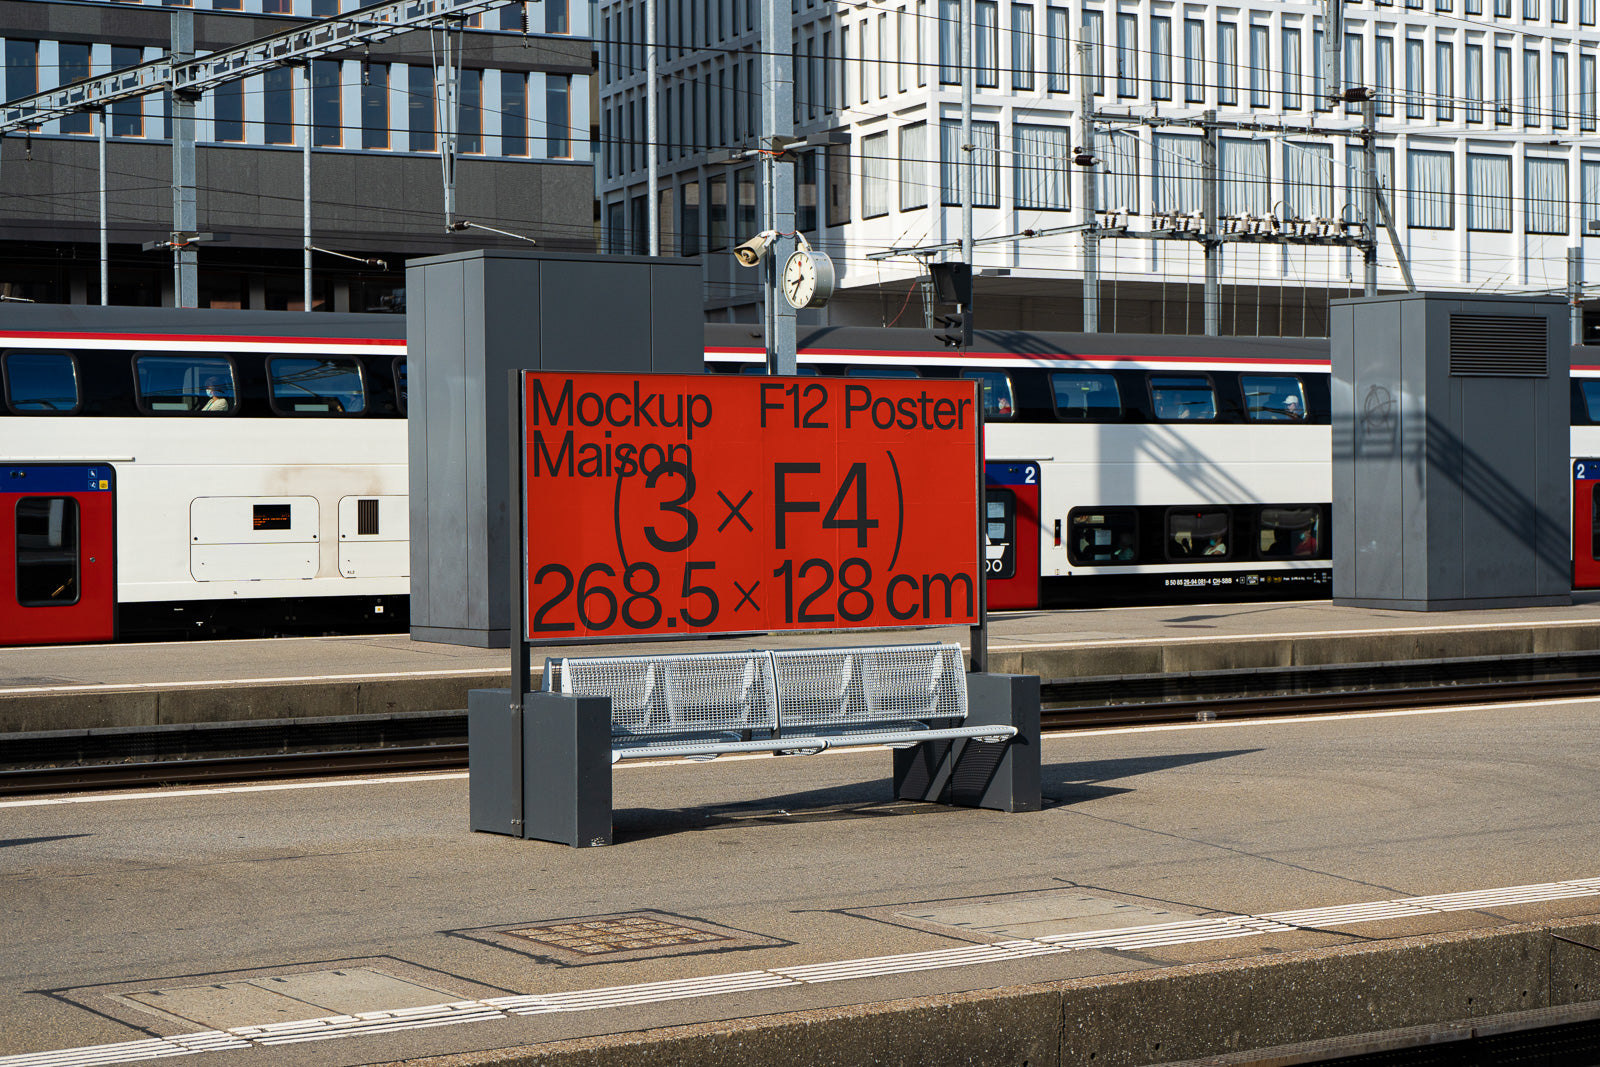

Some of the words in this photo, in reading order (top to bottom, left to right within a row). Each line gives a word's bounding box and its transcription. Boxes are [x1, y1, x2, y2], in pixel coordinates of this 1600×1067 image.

[533, 379, 712, 440] Mockup
[760, 383, 828, 429] F12
[845, 385, 972, 430] Poster
[533, 430, 693, 477] Maison
[1024, 466, 1036, 484] 2
[1577, 463, 1585, 479] 2
[534, 561, 719, 632] 268.5
[774, 558, 874, 623] 128
[886, 573, 974, 620] cm
